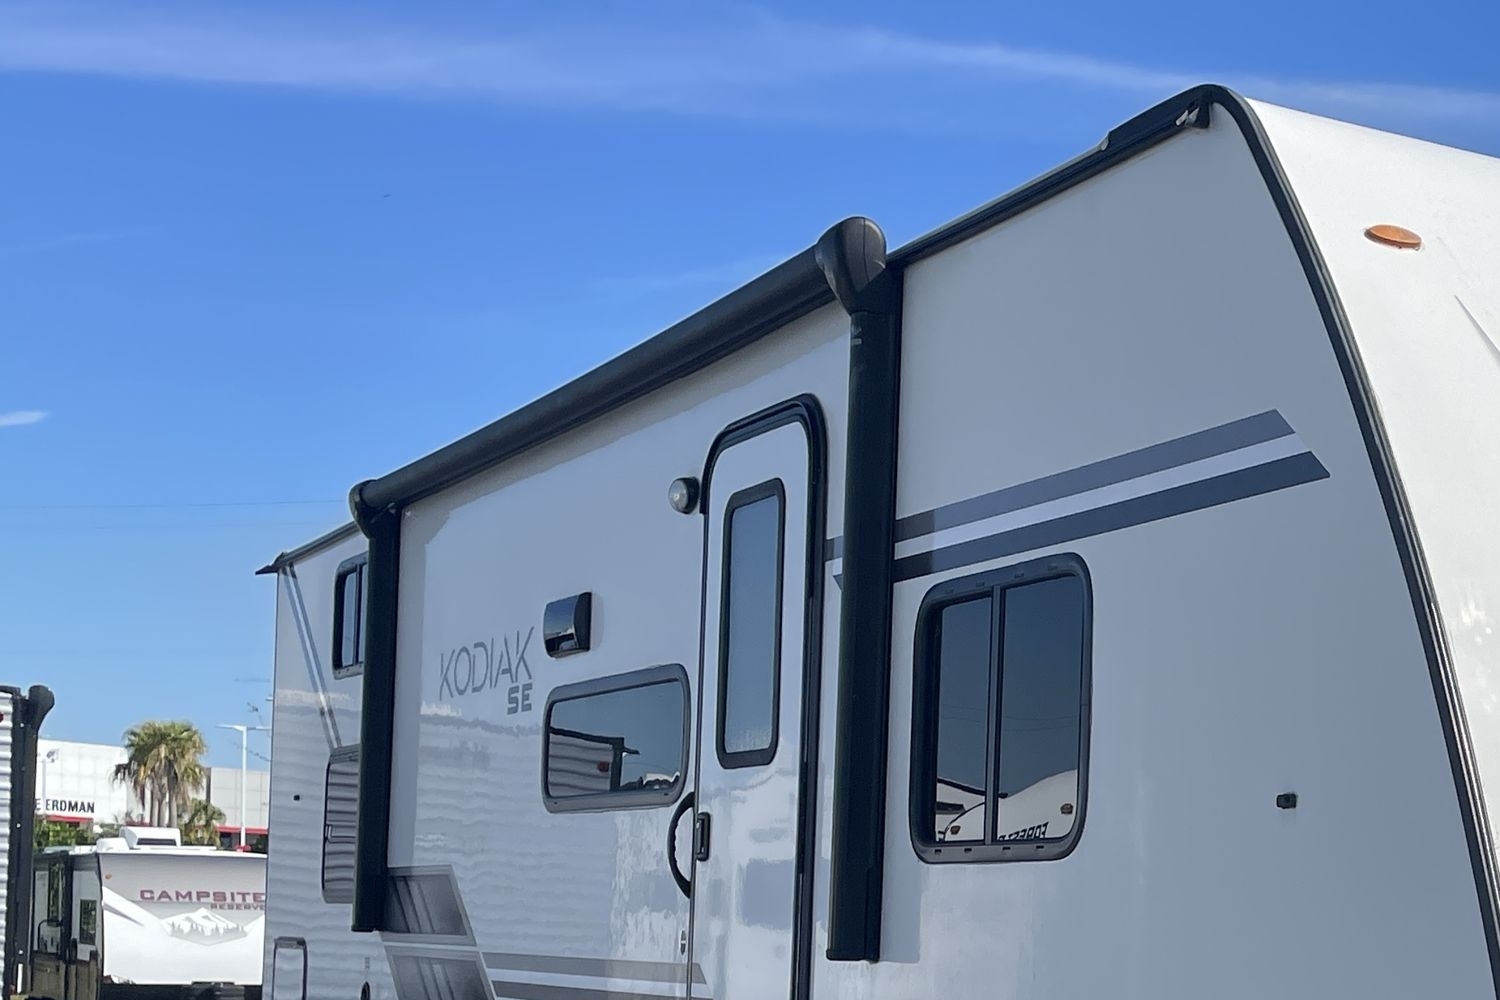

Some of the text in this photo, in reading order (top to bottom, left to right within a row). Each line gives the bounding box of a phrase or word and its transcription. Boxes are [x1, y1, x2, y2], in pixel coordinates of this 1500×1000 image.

[439, 626, 534, 701] KODIAK
[507, 682, 533, 715] SE
[45, 799, 95, 813] ERDMAN
[140, 889, 266, 903] CAMPSITE
